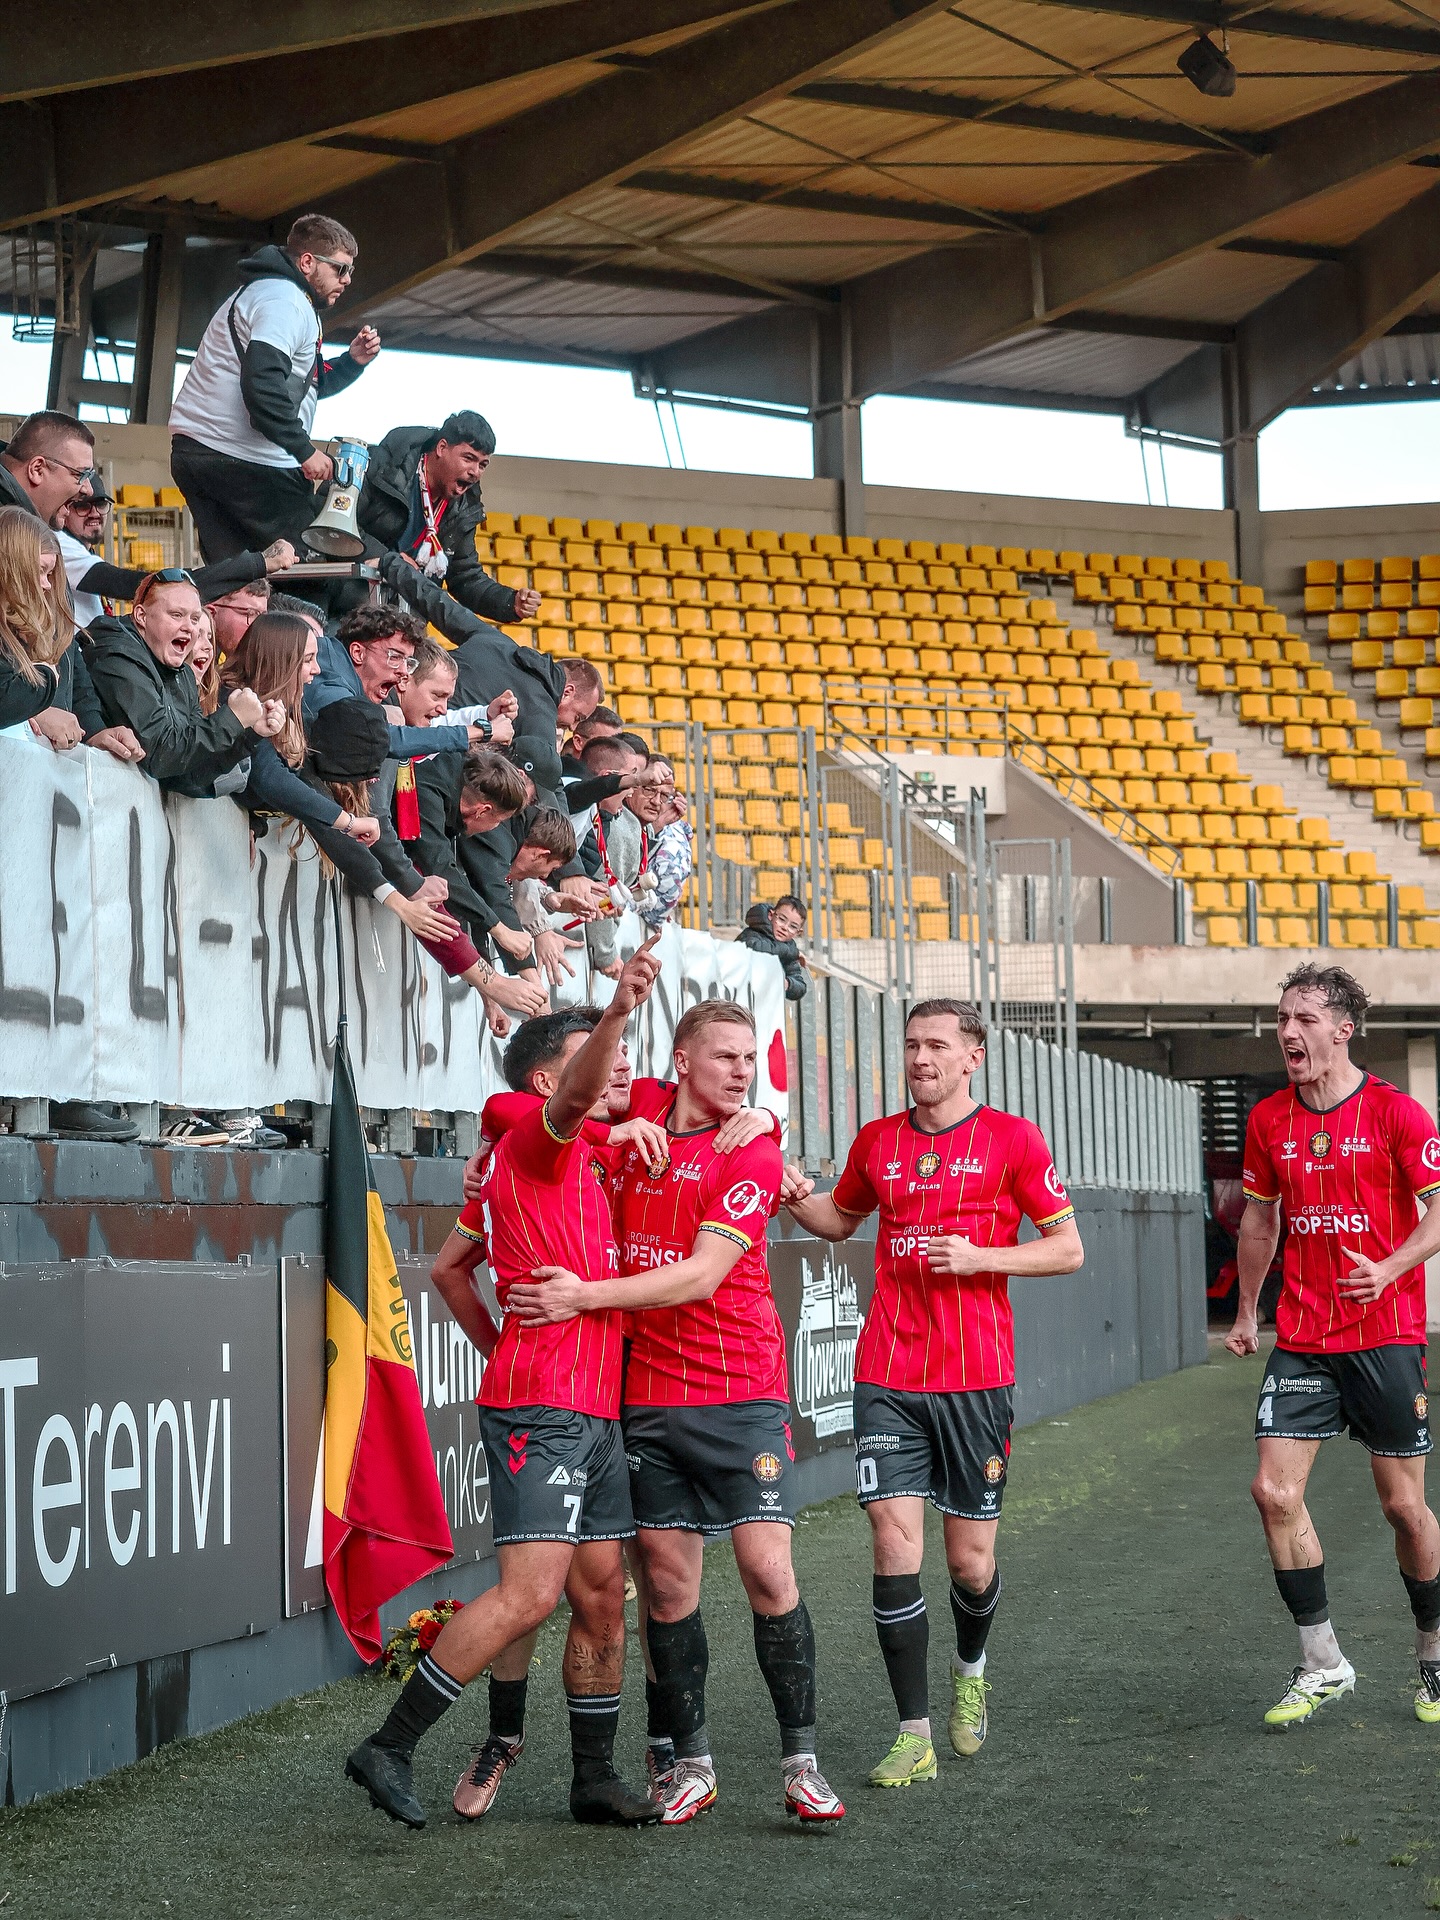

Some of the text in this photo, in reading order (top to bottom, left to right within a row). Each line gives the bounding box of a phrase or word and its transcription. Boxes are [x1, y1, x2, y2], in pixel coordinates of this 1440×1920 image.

[902, 784, 956, 806] RTE
[916, 1183, 941, 1191] CALAIS
[1301, 1204, 1344, 1215] GROUPE
[903, 1224, 944, 1236] GROUPE
[1289, 1214, 1370, 1235] TOPENSI
[625, 1230, 661, 1246] GROUPE
[623, 1241, 684, 1268] OPENSI
[1280, 1377, 1322, 1388] Aluminium
[1278, 1385, 1322, 1394] Dunkerque
[1257, 1396, 1274, 1427] 4
[859, 1433, 900, 1443] Aluminium
[858, 1441, 900, 1453] Dunkerque
[0, 1340, 232, 1597] Terenvi
[563, 1493, 582, 1534] 7
[758, 1504, 783, 1512] hummel
